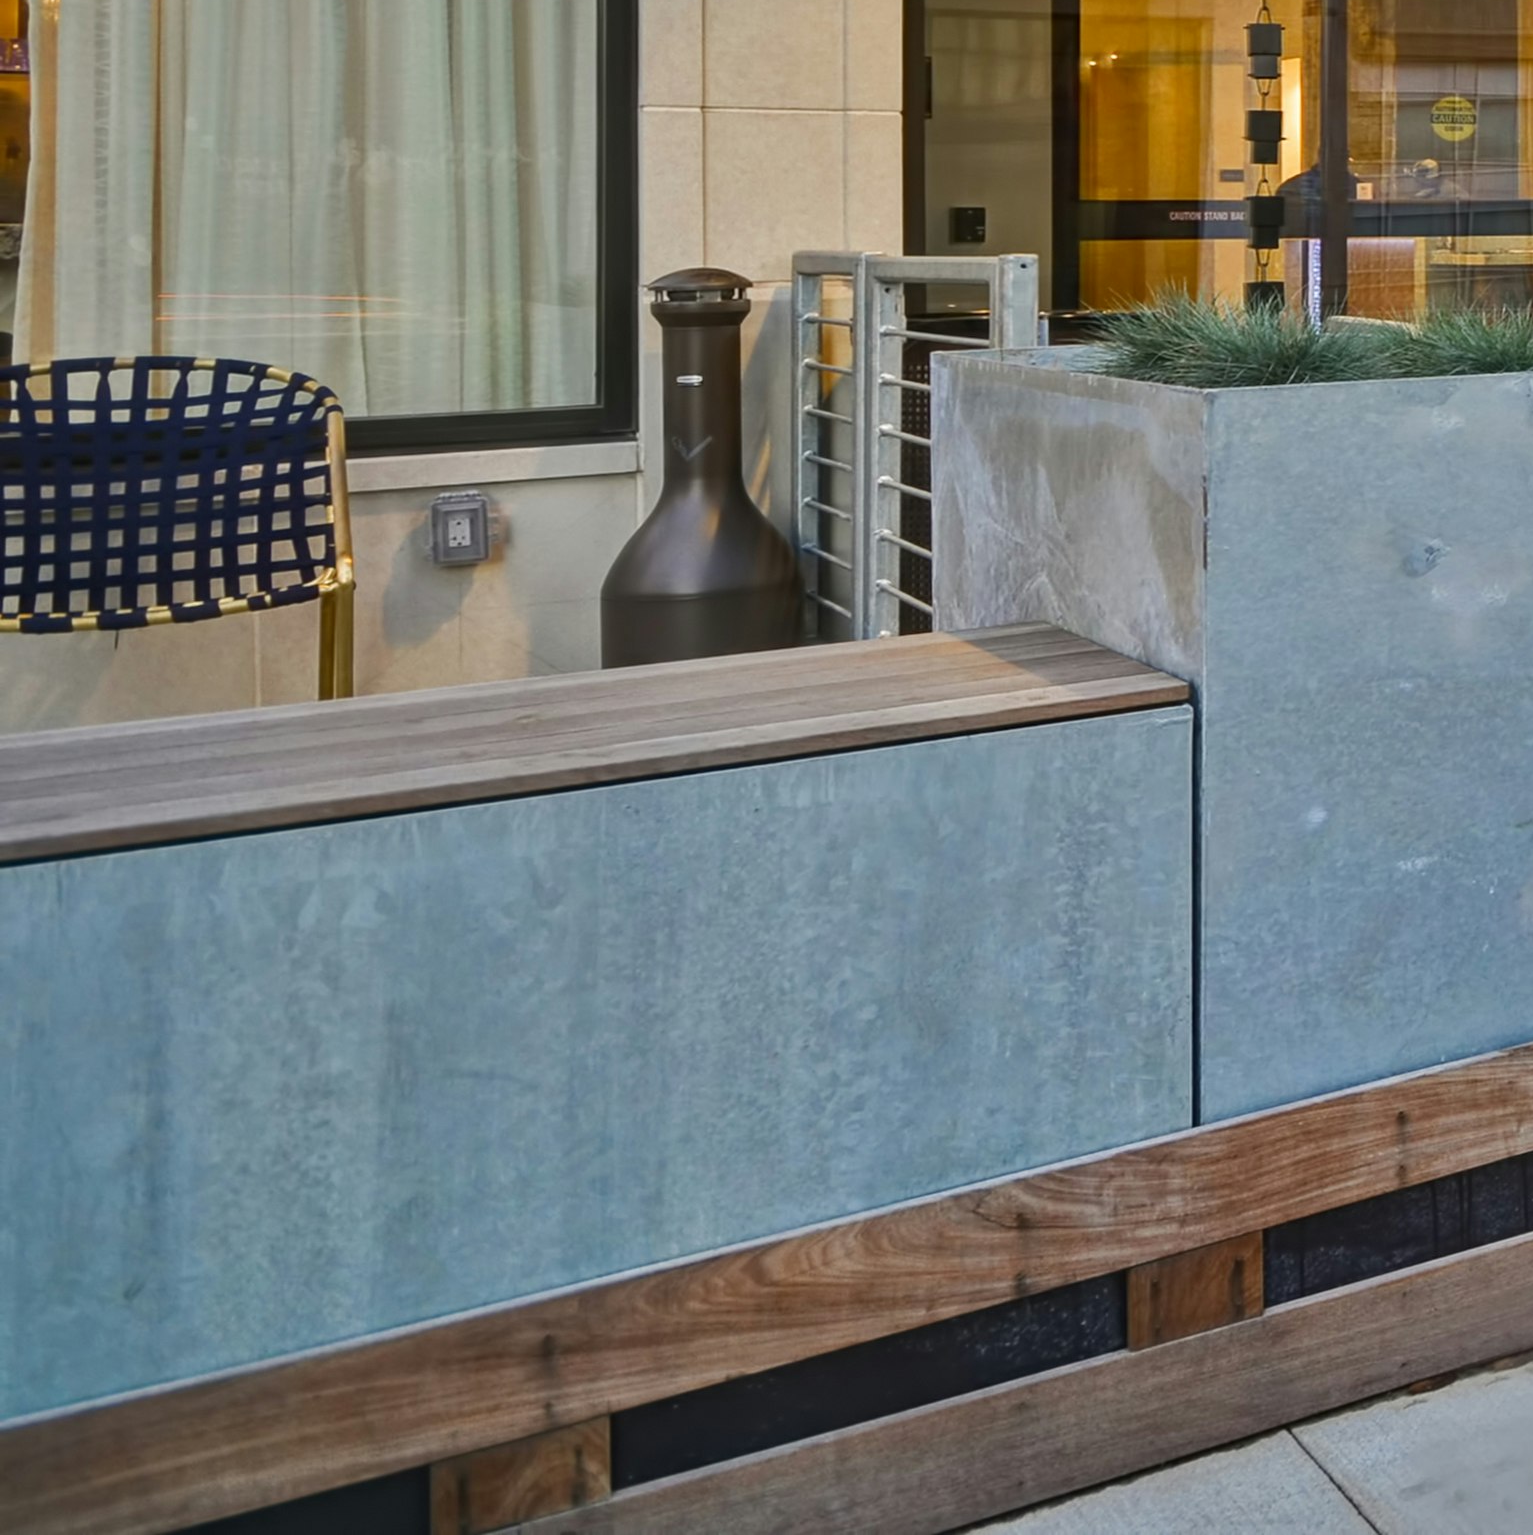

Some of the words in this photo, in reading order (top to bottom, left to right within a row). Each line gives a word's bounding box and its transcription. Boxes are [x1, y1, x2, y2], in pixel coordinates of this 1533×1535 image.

[1432, 115, 1475, 123] CAUTION
[1169, 211, 1202, 221] CAUTION
[1203, 211, 1229, 221] STAND
[1230, 211, 1246, 221] BAC
